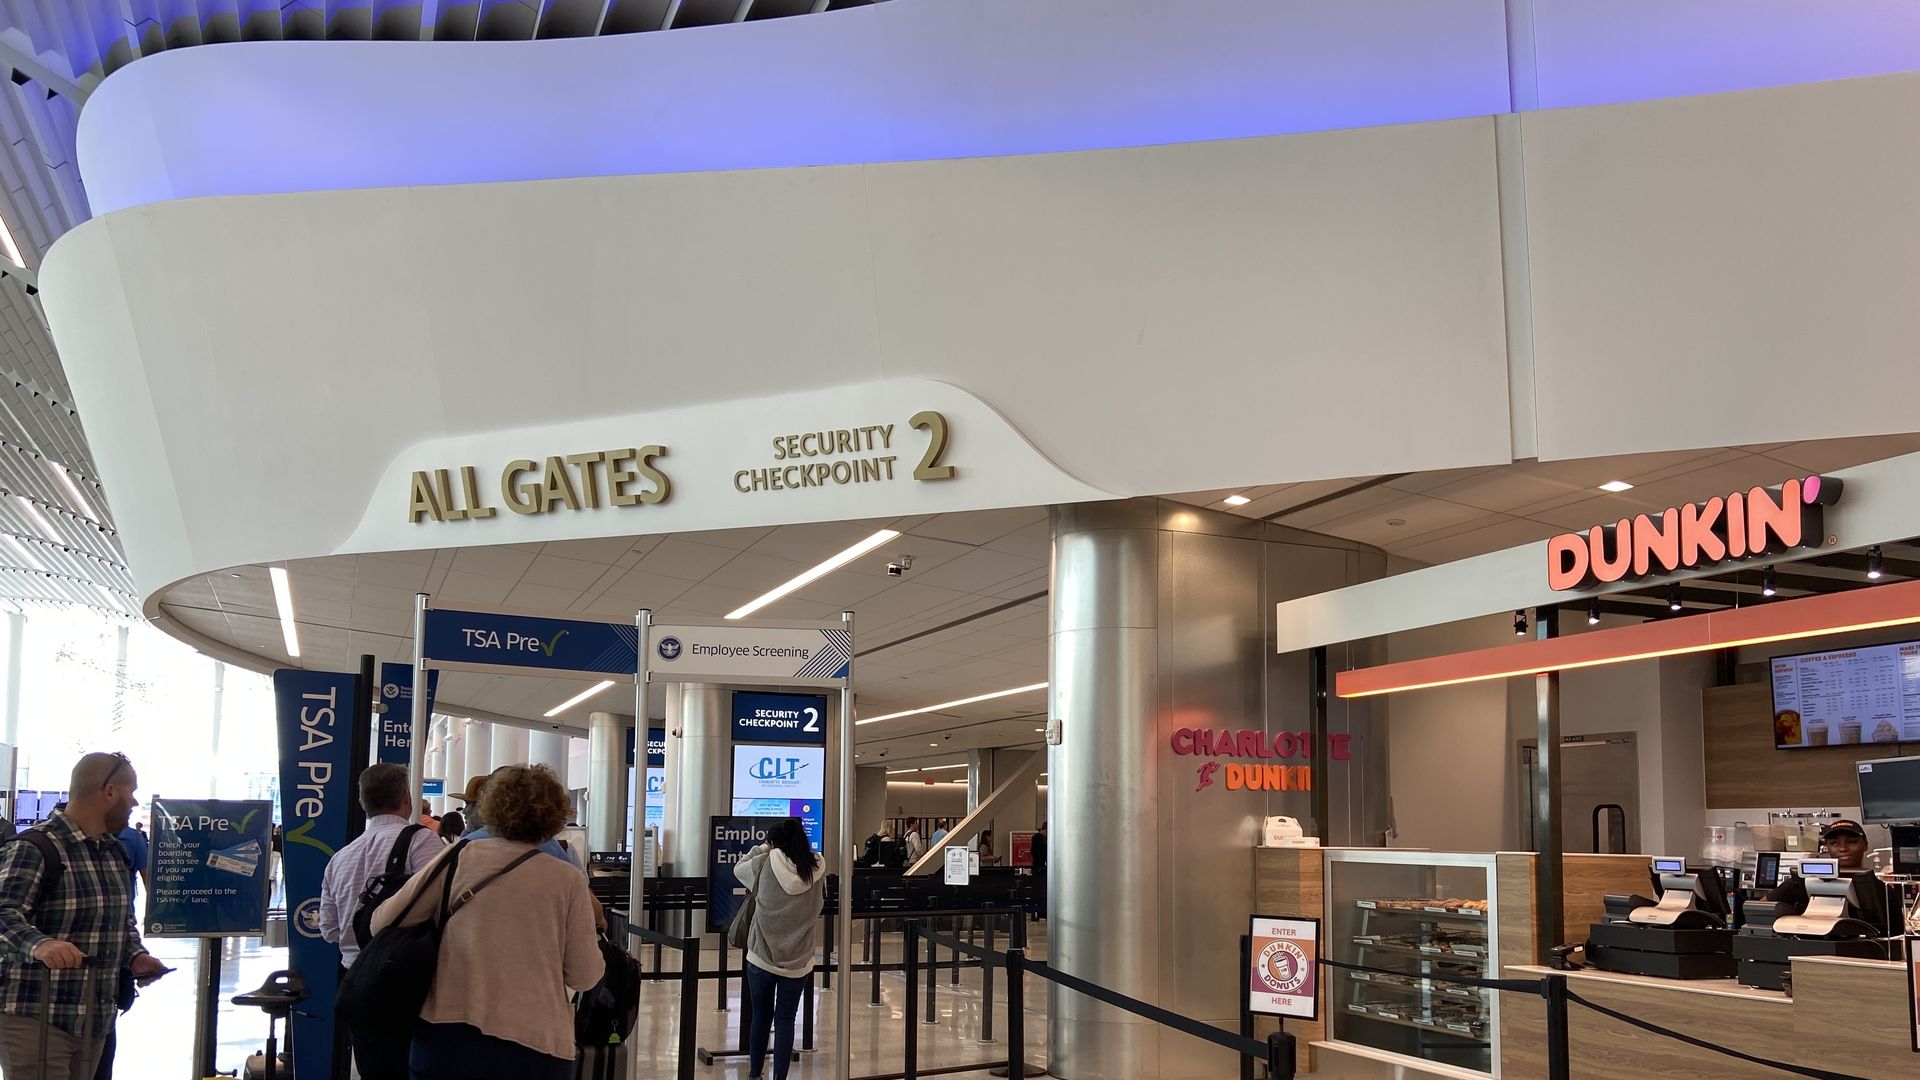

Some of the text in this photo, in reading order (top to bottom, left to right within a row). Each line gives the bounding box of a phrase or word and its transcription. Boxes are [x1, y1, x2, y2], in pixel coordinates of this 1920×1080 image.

[772, 424, 894, 460] SECURITY
[733, 410, 956, 494] CHECKPOINT 2
[409, 445, 672, 524] ALL GATES
[1547, 474, 1824, 592] DUNKIN'
[462, 628, 540, 652] TSA Pre
[692, 643, 809, 659] Employee Screening
[738, 707, 820, 732] CHECKPOINT 2
[755, 709, 800, 719] SECURITY
[384, 720, 413, 733] Ent
[385, 734, 412, 747] Her
[1171, 727, 1352, 761] CHARLOTE
[295, 686, 336, 818] TSA Pre
[758, 757, 800, 780] CLT
[158, 815, 229, 831] TSA Pre
[715, 826, 768, 844] Emplo
[182, 888, 213, 896] proceed
[1271, 927, 1297, 937] ENTER
[1264, 974, 1301, 990] DONUTS
[1271, 997, 1293, 1006] HERE
